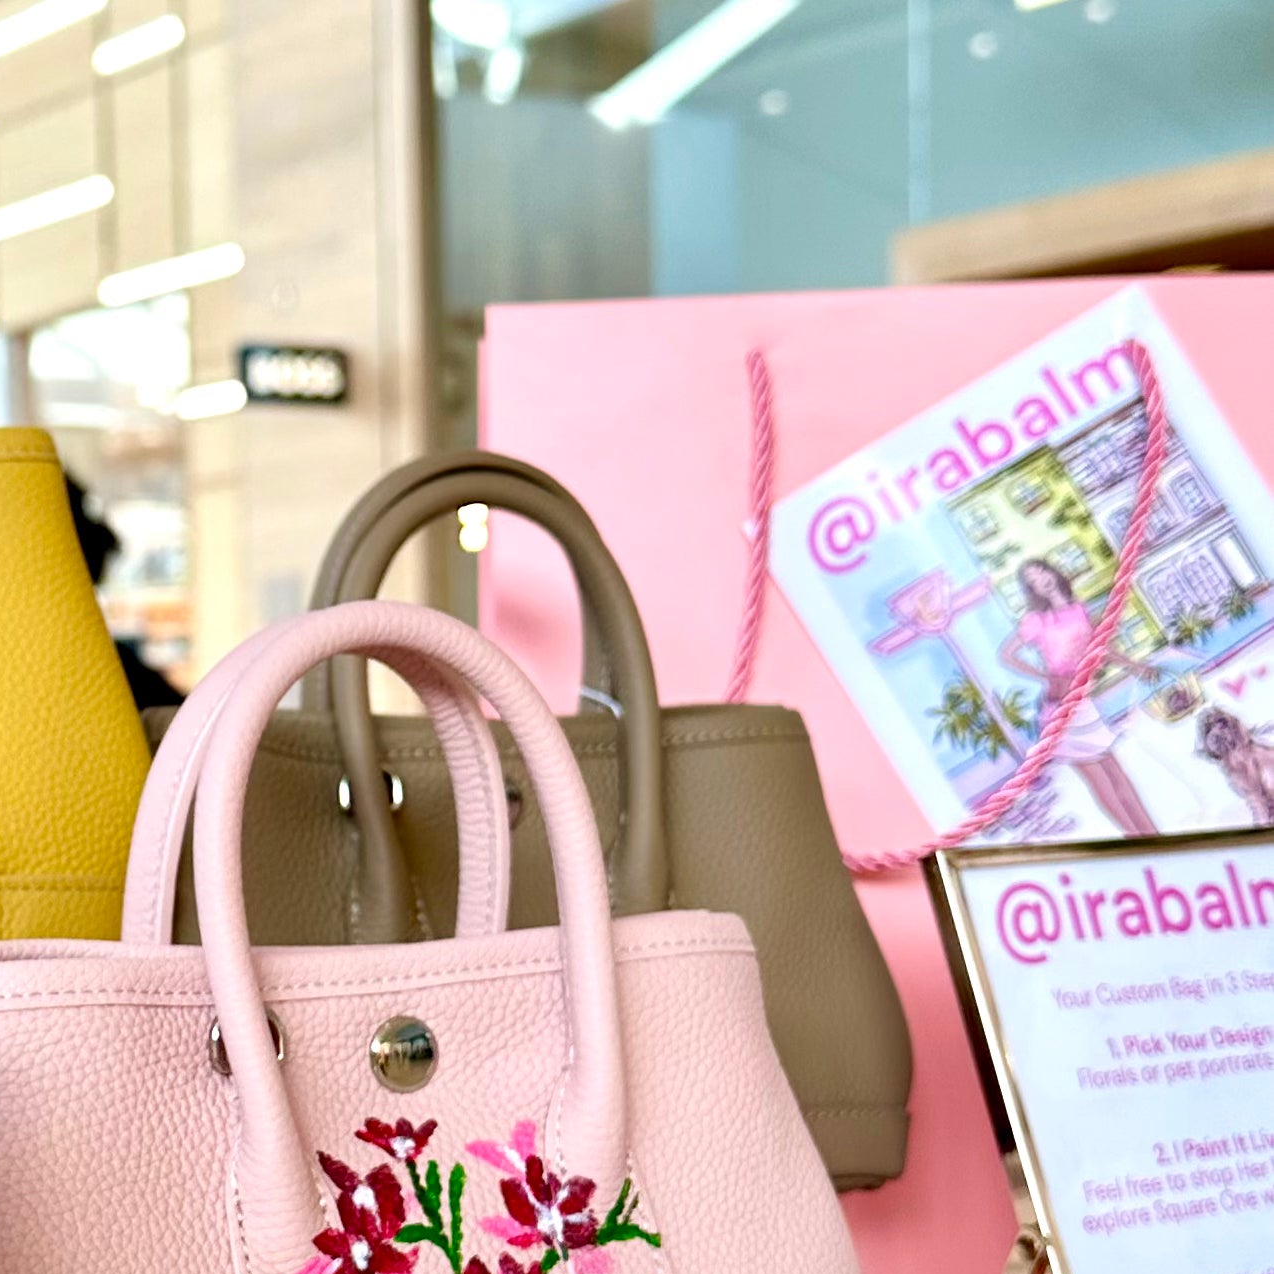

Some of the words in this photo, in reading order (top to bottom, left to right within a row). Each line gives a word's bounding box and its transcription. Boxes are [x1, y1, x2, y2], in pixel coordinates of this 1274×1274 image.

[1052, 987, 1092, 1009] Your
[1095, 976, 1169, 1006] Custom
[1169, 975, 1206, 1002] Bag
[1204, 972, 1224, 995] in
[1226, 970, 1240, 995] 3
[1123, 1033, 1165, 1057] Pick
[1165, 1031, 1208, 1054] Your
[1077, 1064, 1139, 1090] Florals
[1141, 1064, 1160, 1084] or
[1163, 1060, 1195, 1087] pet
[1182, 1134, 1231, 1162] Paint
[1232, 1130, 1248, 1155] It
[1082, 1176, 1123, 1203] Feel
[1125, 1173, 1164, 1199] free
[1166, 1172, 1187, 1192] to
[1190, 1166, 1234, 1190] shop
[1082, 1207, 1152, 1237] explore
[1153, 1196, 1218, 1226] Square
[1220, 1187, 1259, 1213] One
